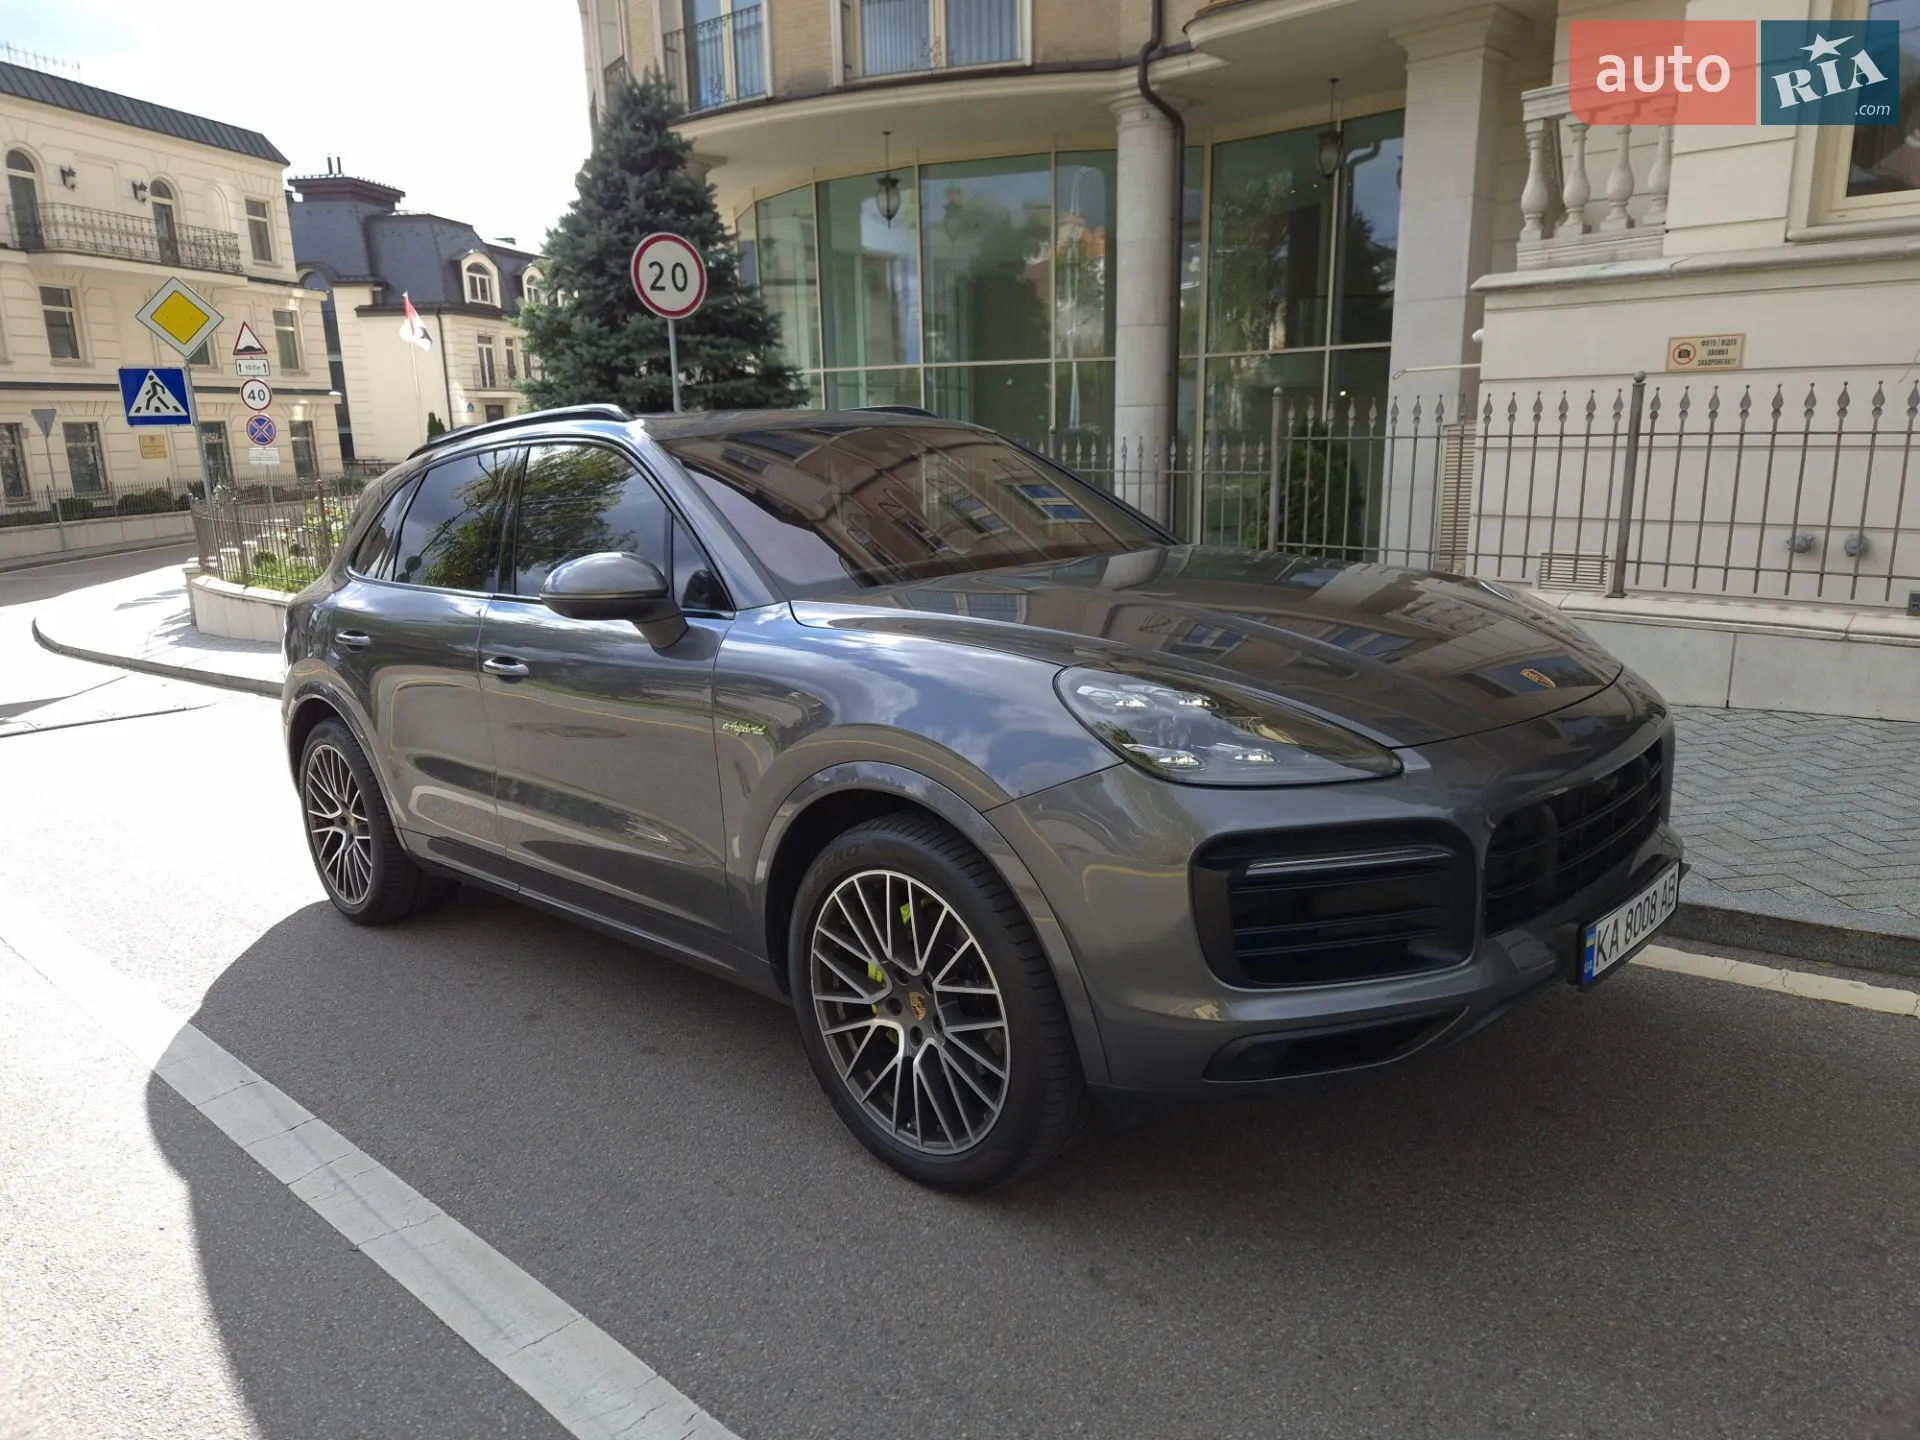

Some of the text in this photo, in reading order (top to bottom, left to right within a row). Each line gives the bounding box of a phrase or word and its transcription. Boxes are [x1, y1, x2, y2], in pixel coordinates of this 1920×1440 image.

[648, 261, 688, 293] 20
[247, 388, 266, 402] 40
[1596, 873, 1676, 968] KA 8008 AB
